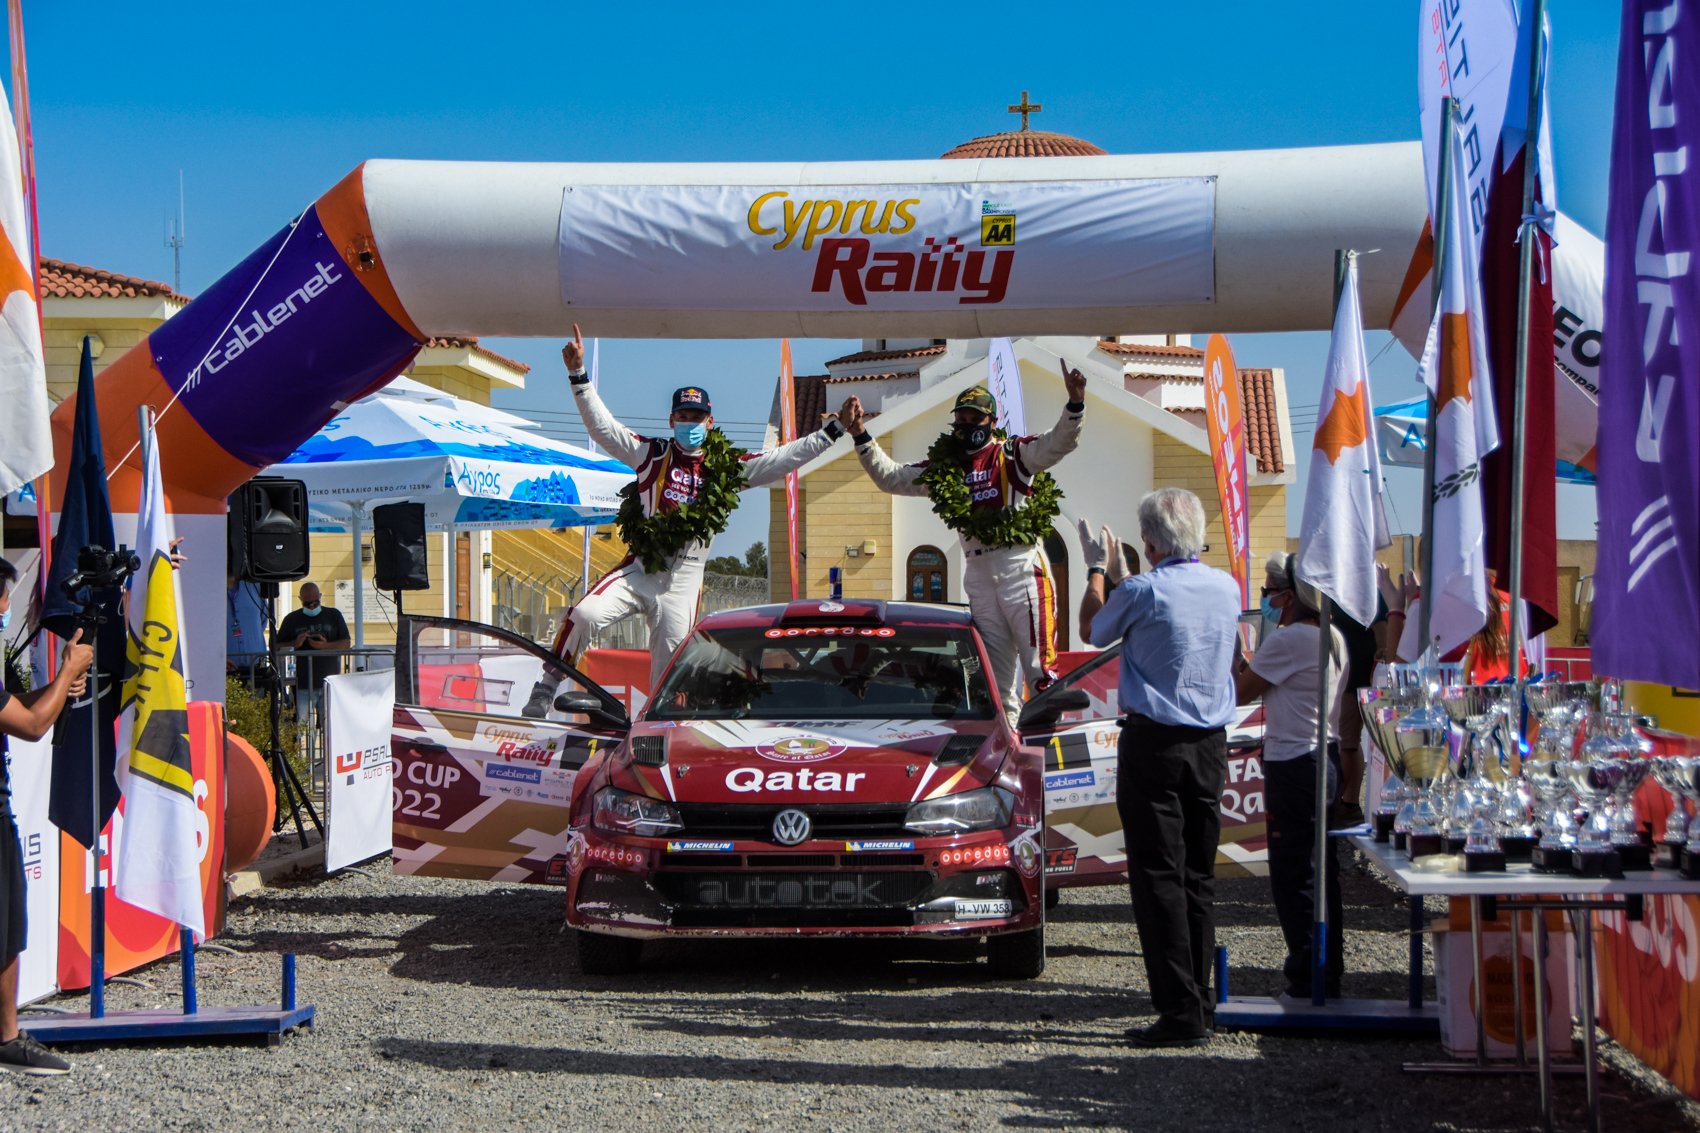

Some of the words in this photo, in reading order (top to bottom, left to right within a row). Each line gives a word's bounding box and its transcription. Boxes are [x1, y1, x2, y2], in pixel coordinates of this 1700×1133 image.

[747, 191, 920, 251] Cyprus
[985, 224, 1012, 242] AA
[811, 237, 1015, 305] Rally
[204, 261, 342, 374] cablenet
[965, 468, 993, 484] atar
[308, 488, 329, 496] ΥΣΙΚΟ
[332, 487, 372, 495] ΜΕΤΑΛΛΙΚΟ
[770, 626, 890, 637] ooredoo
[484, 725, 533, 744] Cyprus
[1094, 731, 1120, 749] Cyp
[496, 742, 555, 767] Rally
[587, 738, 598, 759] 1
[1050, 736, 1064, 769] 1
[363, 769, 383, 781] AUTO
[407, 761, 461, 789] CUP
[496, 769, 539, 781] cablenet
[725, 767, 865, 794] Qatar
[1046, 775, 1092, 788] cablenet
[863, 841, 911, 849] MICHELIN
[587, 848, 642, 863] ooredoo
[942, 846, 1009, 863] ooredoo
[1046, 849, 1076, 866] TS
[994, 903, 1010, 914] 358
